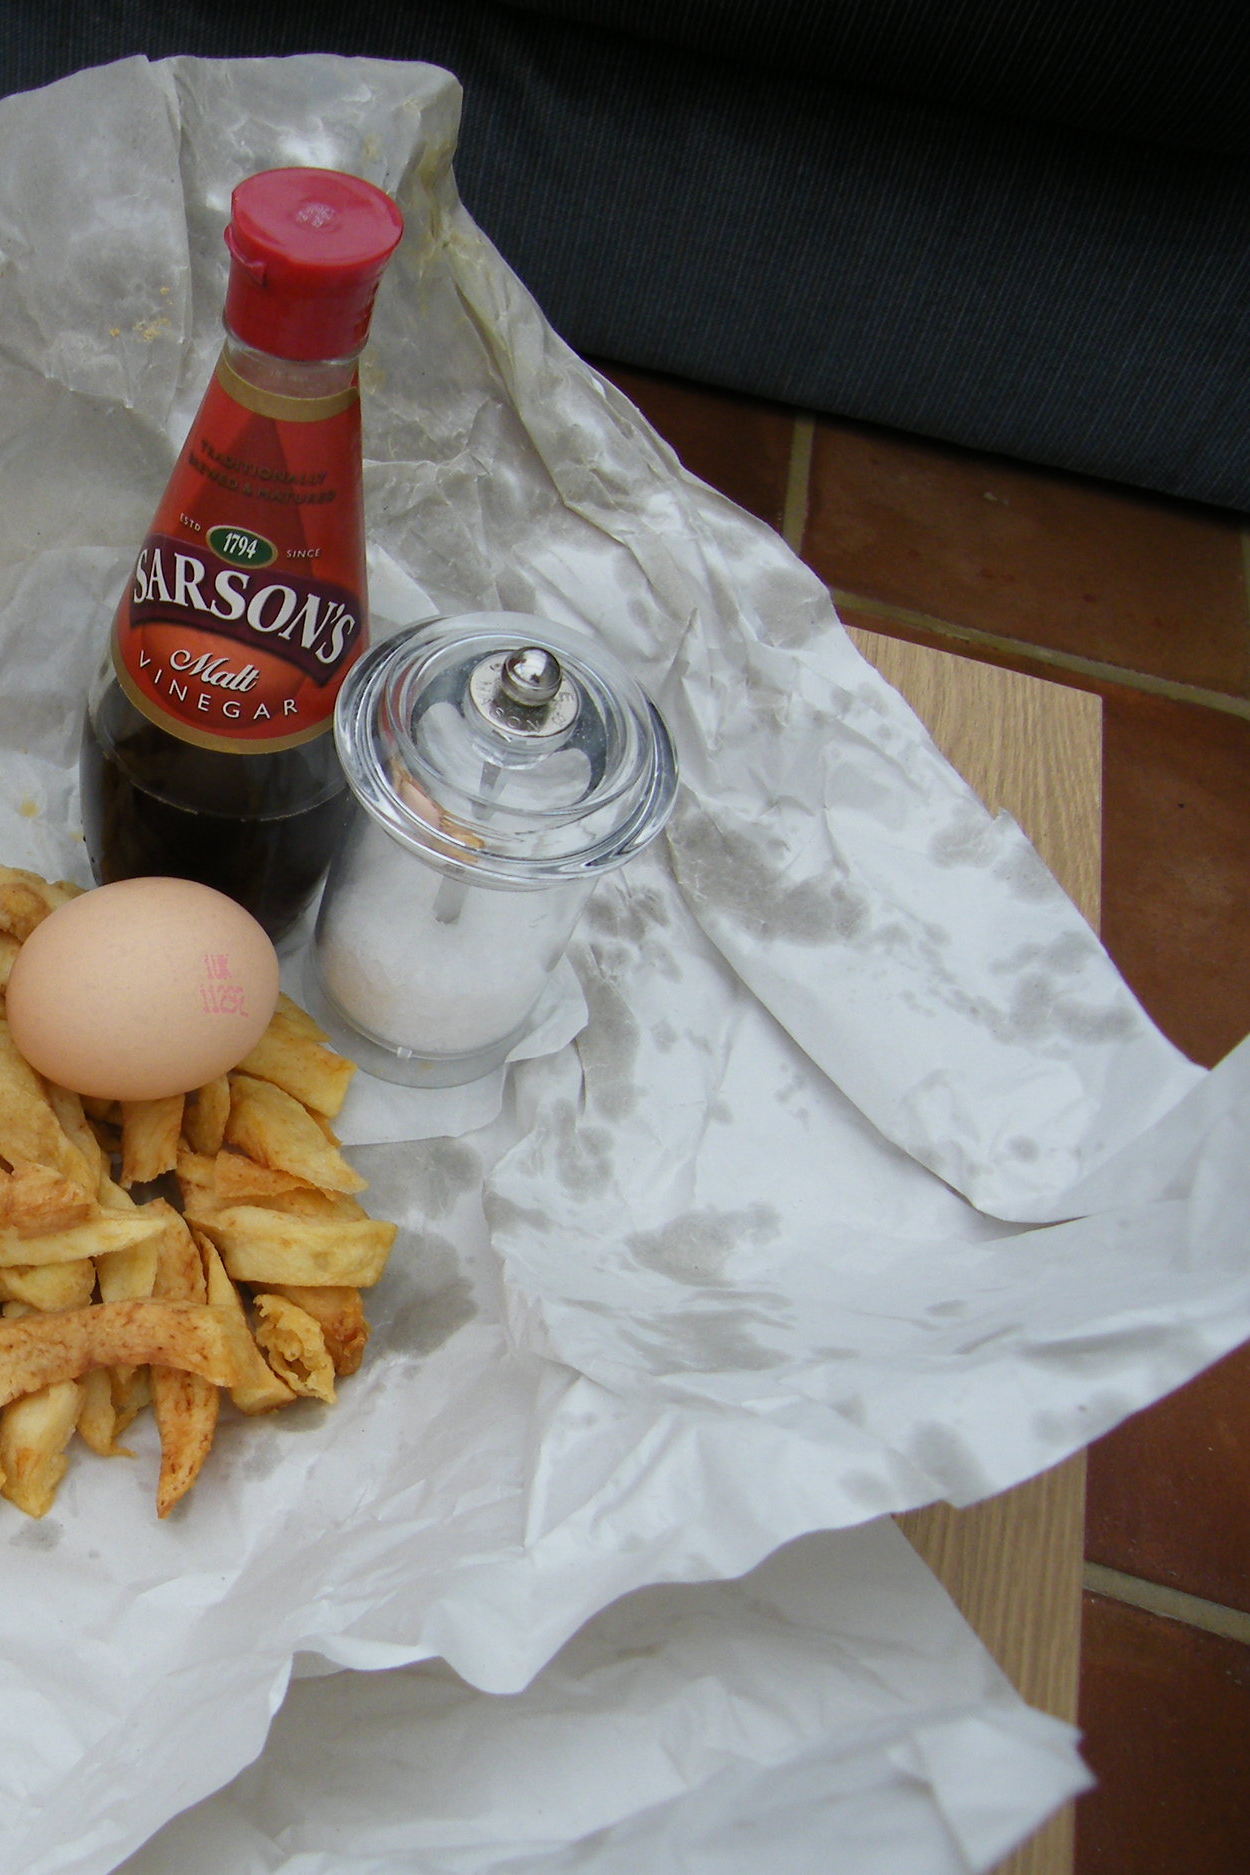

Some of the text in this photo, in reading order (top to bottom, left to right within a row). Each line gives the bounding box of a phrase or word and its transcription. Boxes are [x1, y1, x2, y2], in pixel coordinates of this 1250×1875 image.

[188, 451, 238, 491] BREWED
[257, 487, 337, 505] MATURED
[201, 439, 327, 486] TRADITIONALLY
[179, 512, 321, 559] ESTD 1794 SINCE
[133, 548, 357, 665] SARSON'S
[138, 650, 298, 721] VINEGAR
[169, 649, 260, 692] Malt
